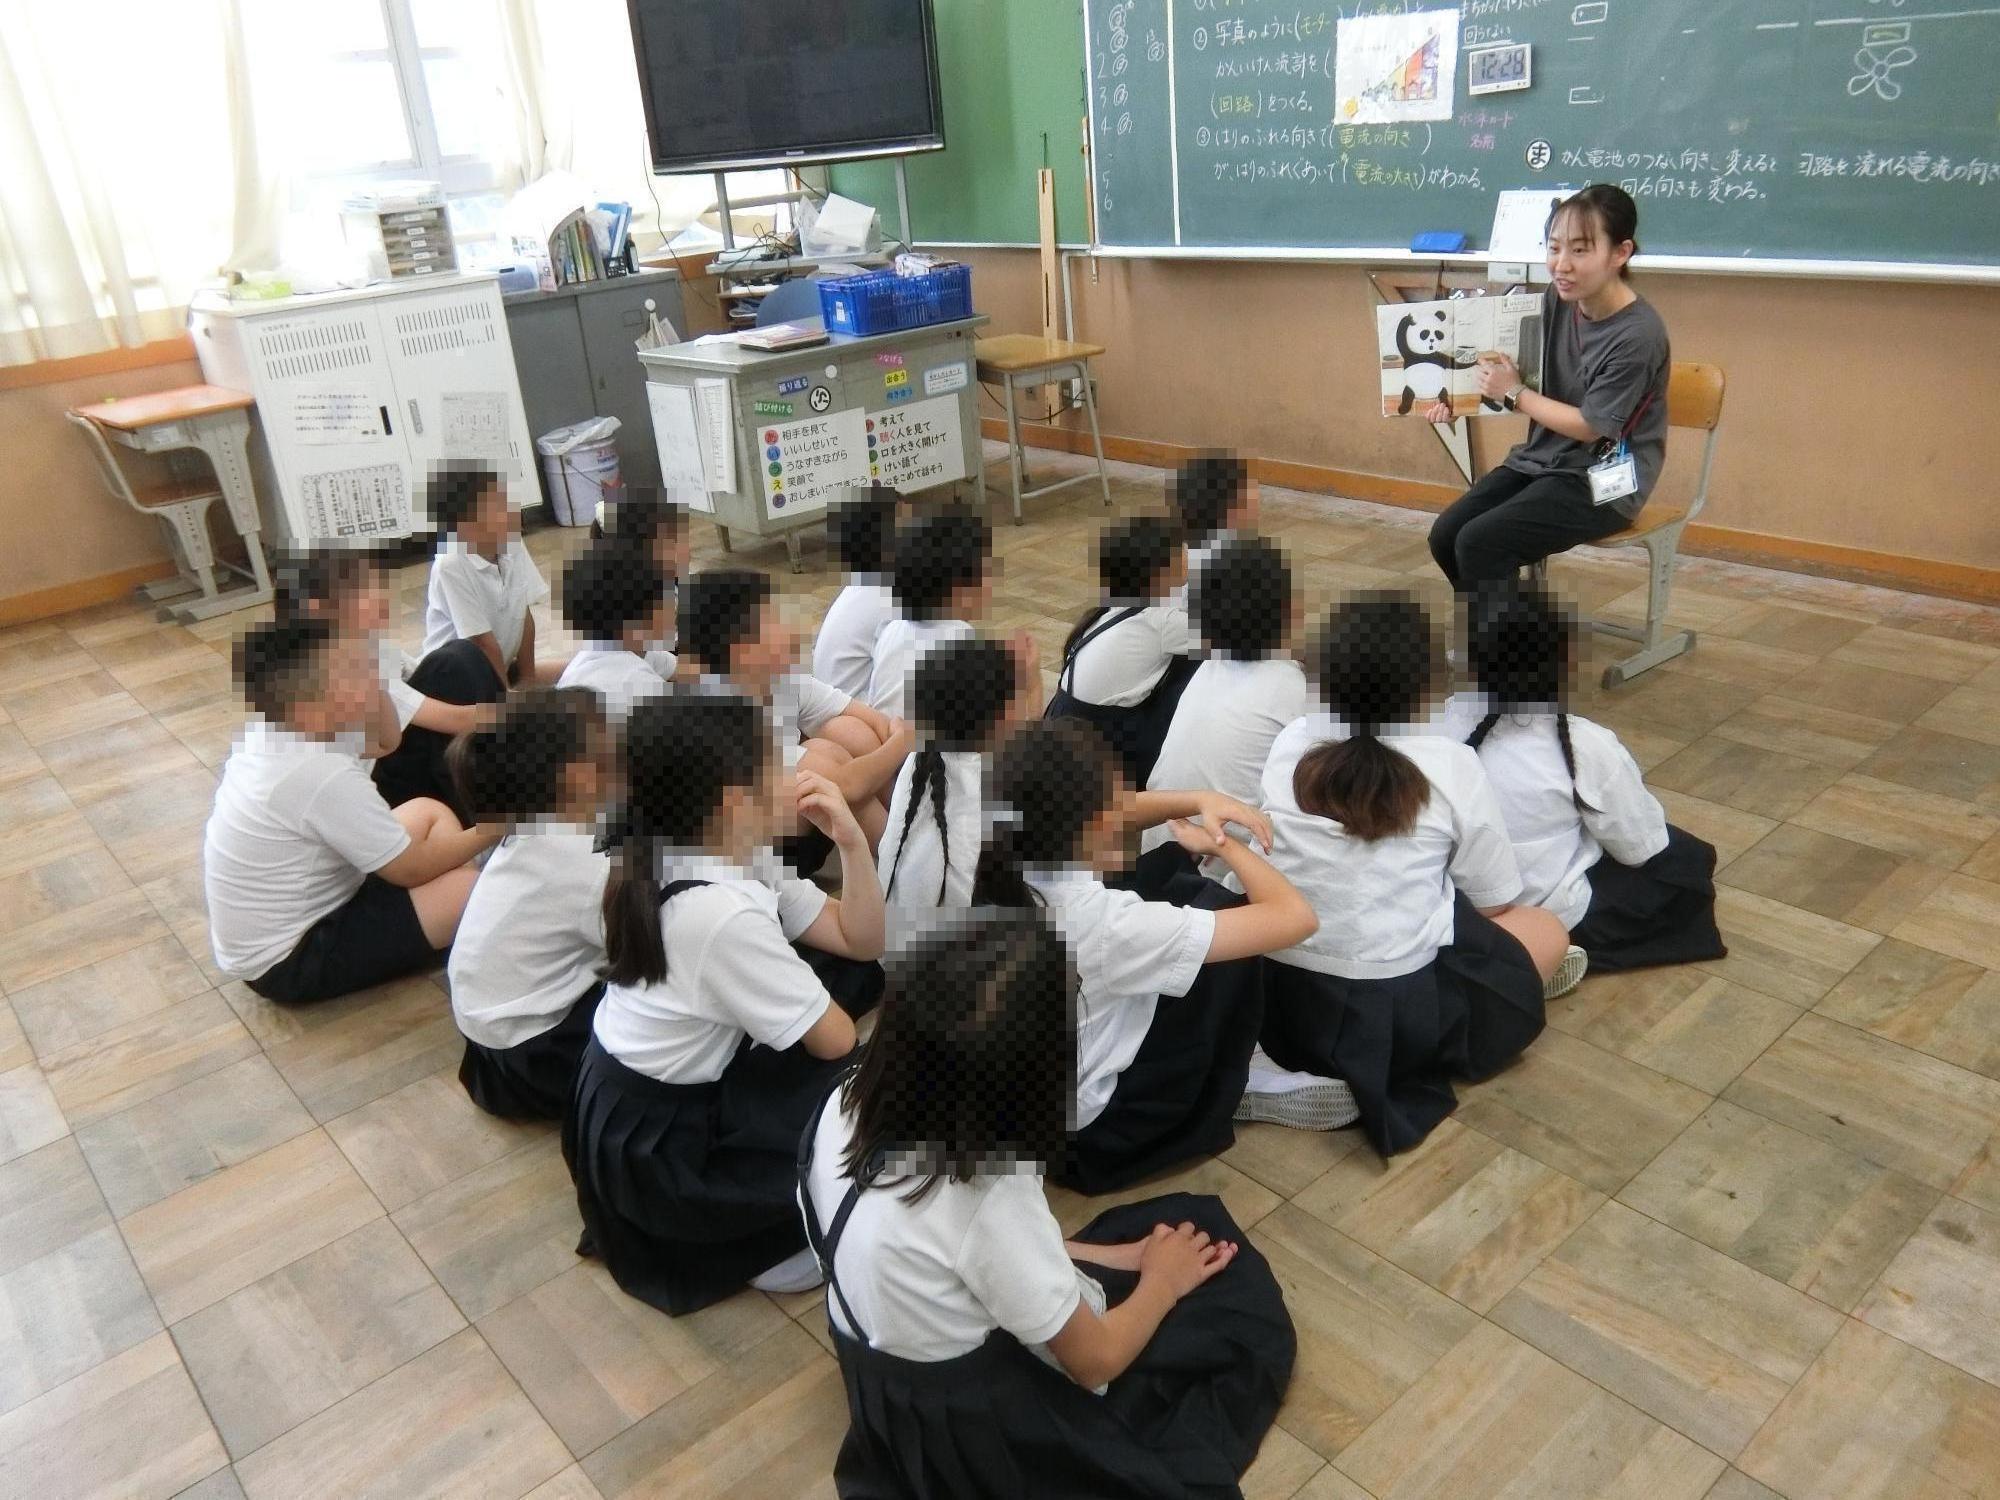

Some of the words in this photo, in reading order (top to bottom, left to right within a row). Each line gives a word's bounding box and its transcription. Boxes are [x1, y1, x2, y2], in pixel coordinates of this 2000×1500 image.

[1531, 143, 1548, 165] ま
[880, 412, 905, 428] 考えて
[782, 422, 828, 440] 相手を見て
[784, 436, 841, 456] いいしせいで
[881, 432, 947, 458] 口を大きく開けて
[786, 449, 848, 471] うなずきながら
[787, 472, 815, 487] 笑顔で
[883, 462, 944, 487] 心をこめて話そう
